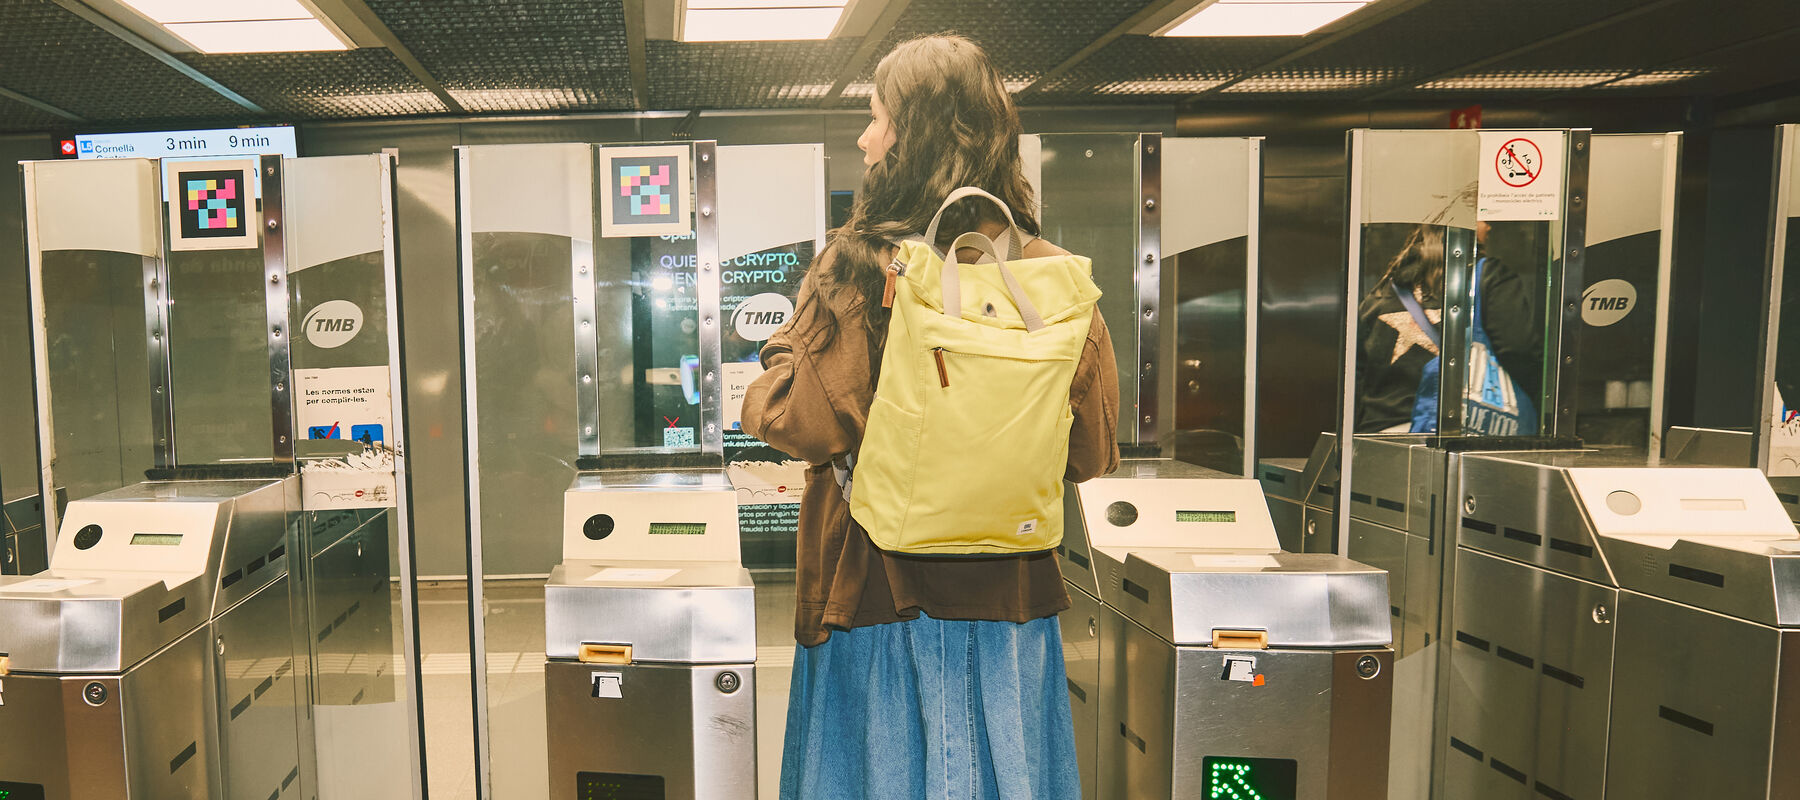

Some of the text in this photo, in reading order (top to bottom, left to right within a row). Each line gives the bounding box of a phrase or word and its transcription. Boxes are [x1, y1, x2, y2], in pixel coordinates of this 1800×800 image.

[81, 142, 92, 151] L5
[166, 137, 207, 150] 3 min
[229, 134, 270, 147] 9 min
[734, 253, 799, 266] CRYPTO.
[721, 270, 786, 283] CRYPTO.
[1590, 297, 1628, 311] TMB
[744, 311, 785, 325] TMB
[315, 318, 355, 332] TMB
